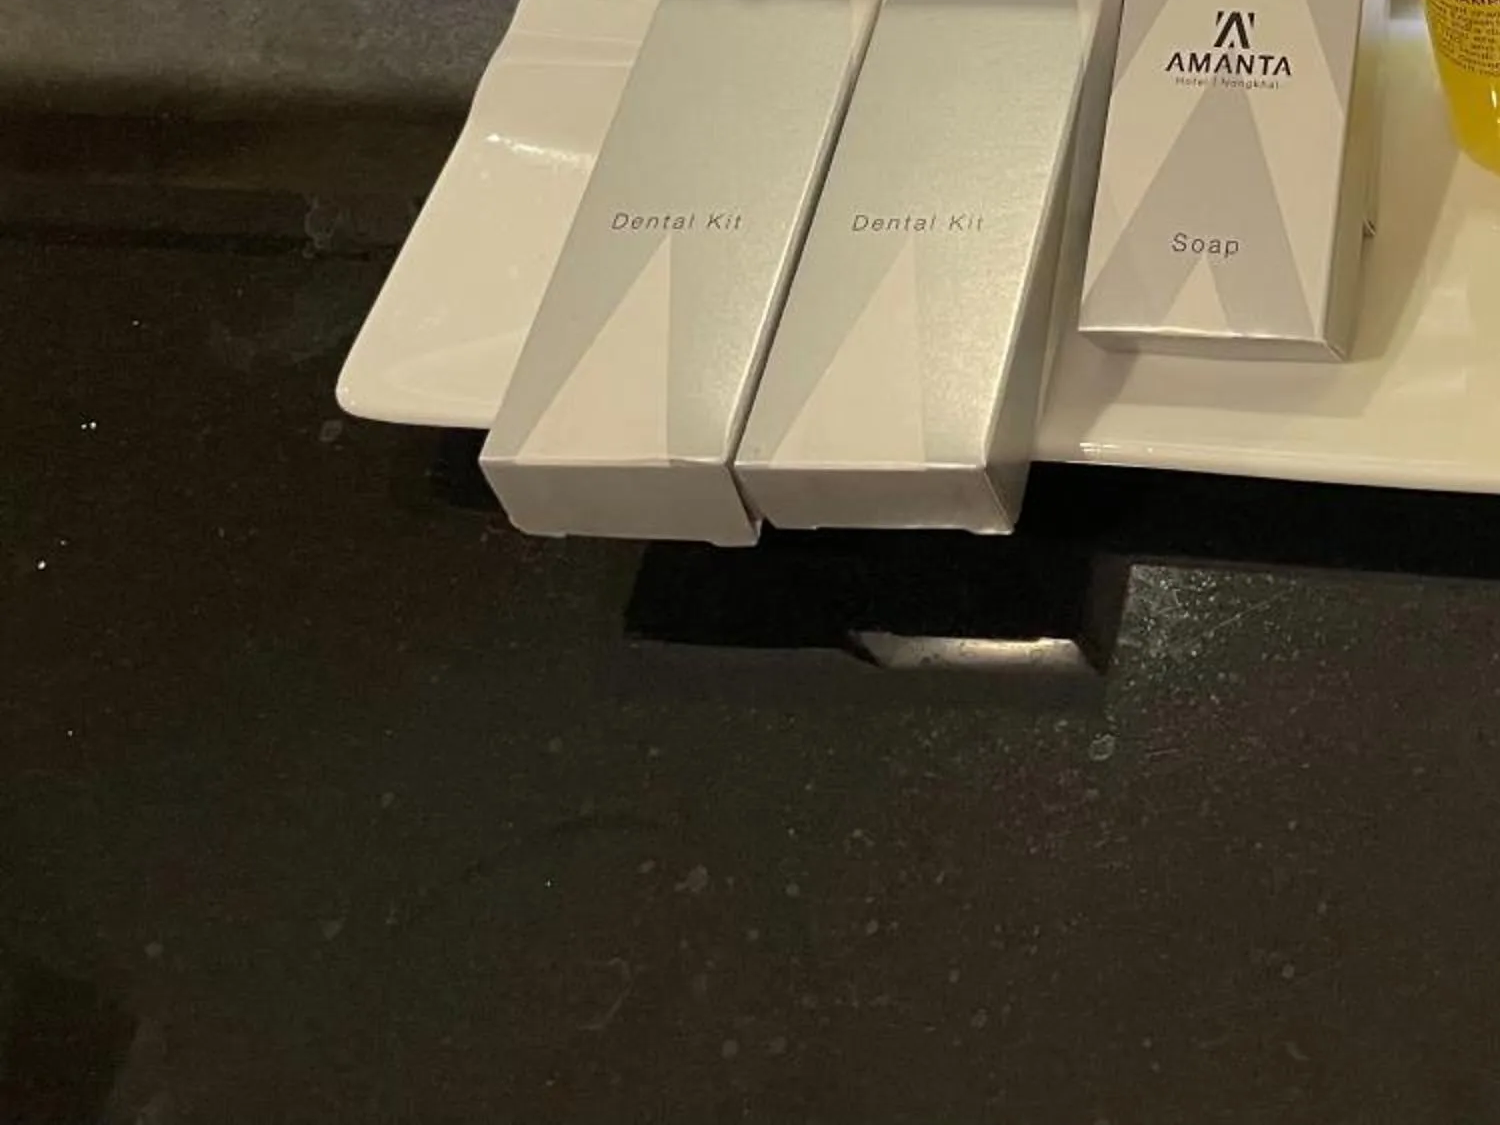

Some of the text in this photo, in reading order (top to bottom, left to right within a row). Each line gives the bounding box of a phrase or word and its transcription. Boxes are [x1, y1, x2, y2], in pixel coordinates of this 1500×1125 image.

[1164, 51, 1293, 76] AMANTA
[611, 213, 744, 231] Dental Kit
[851, 213, 985, 232] Dental Kit
[1171, 231, 1240, 258] Soap
